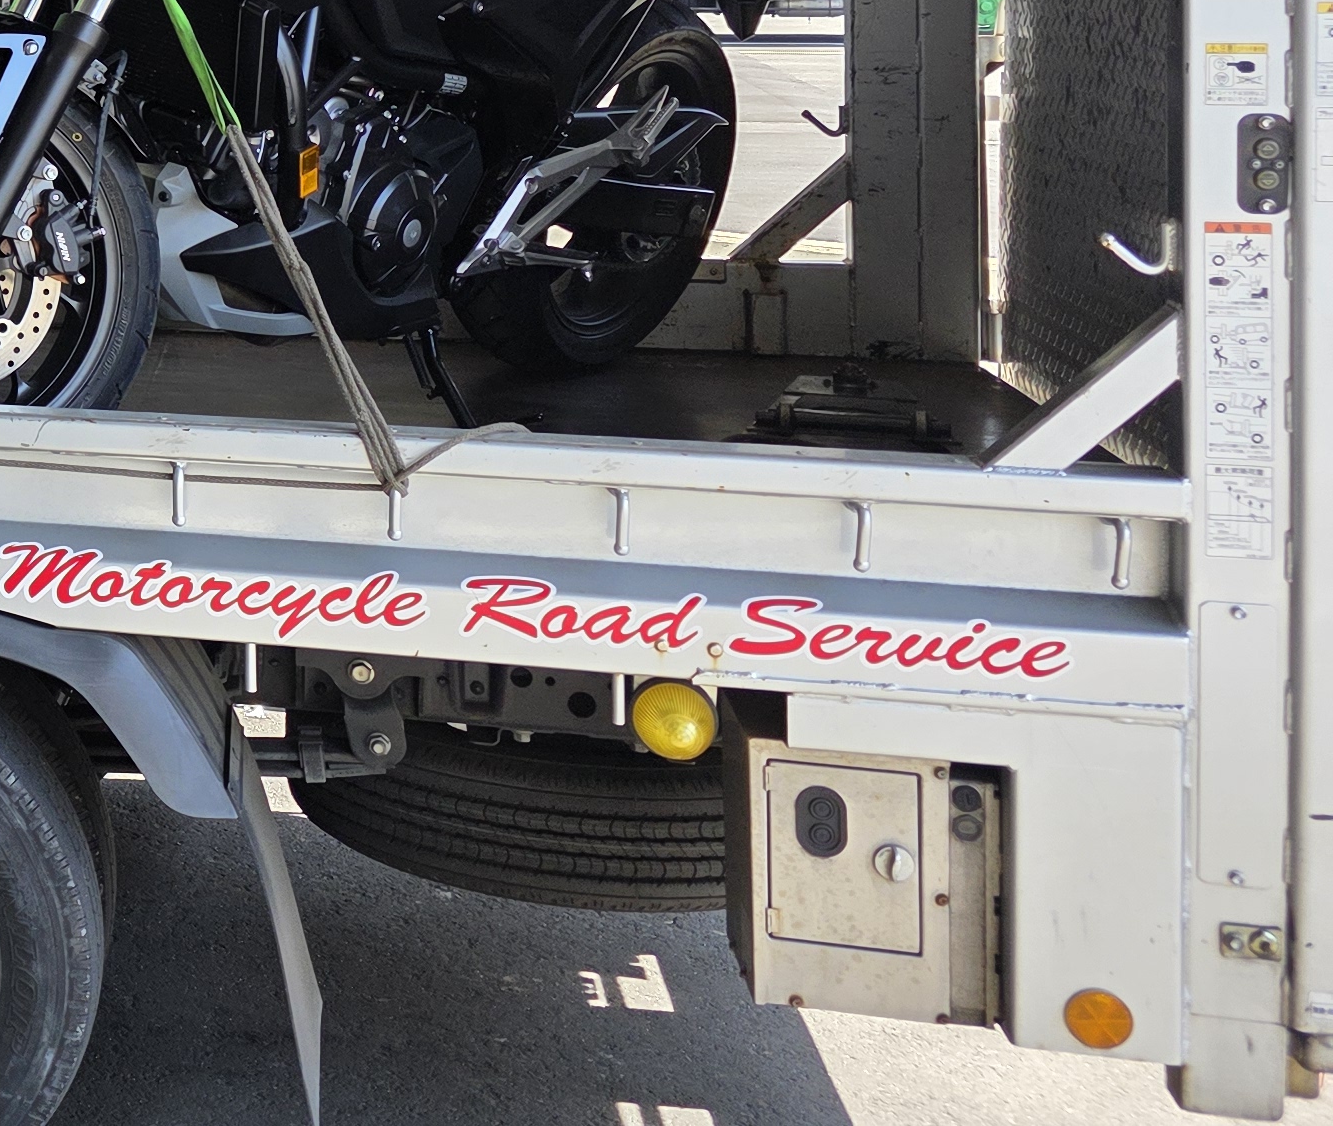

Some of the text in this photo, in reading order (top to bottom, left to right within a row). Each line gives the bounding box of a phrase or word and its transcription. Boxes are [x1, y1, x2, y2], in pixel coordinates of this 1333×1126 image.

[4, 545, 1070, 677] Motorcycle Road Service
